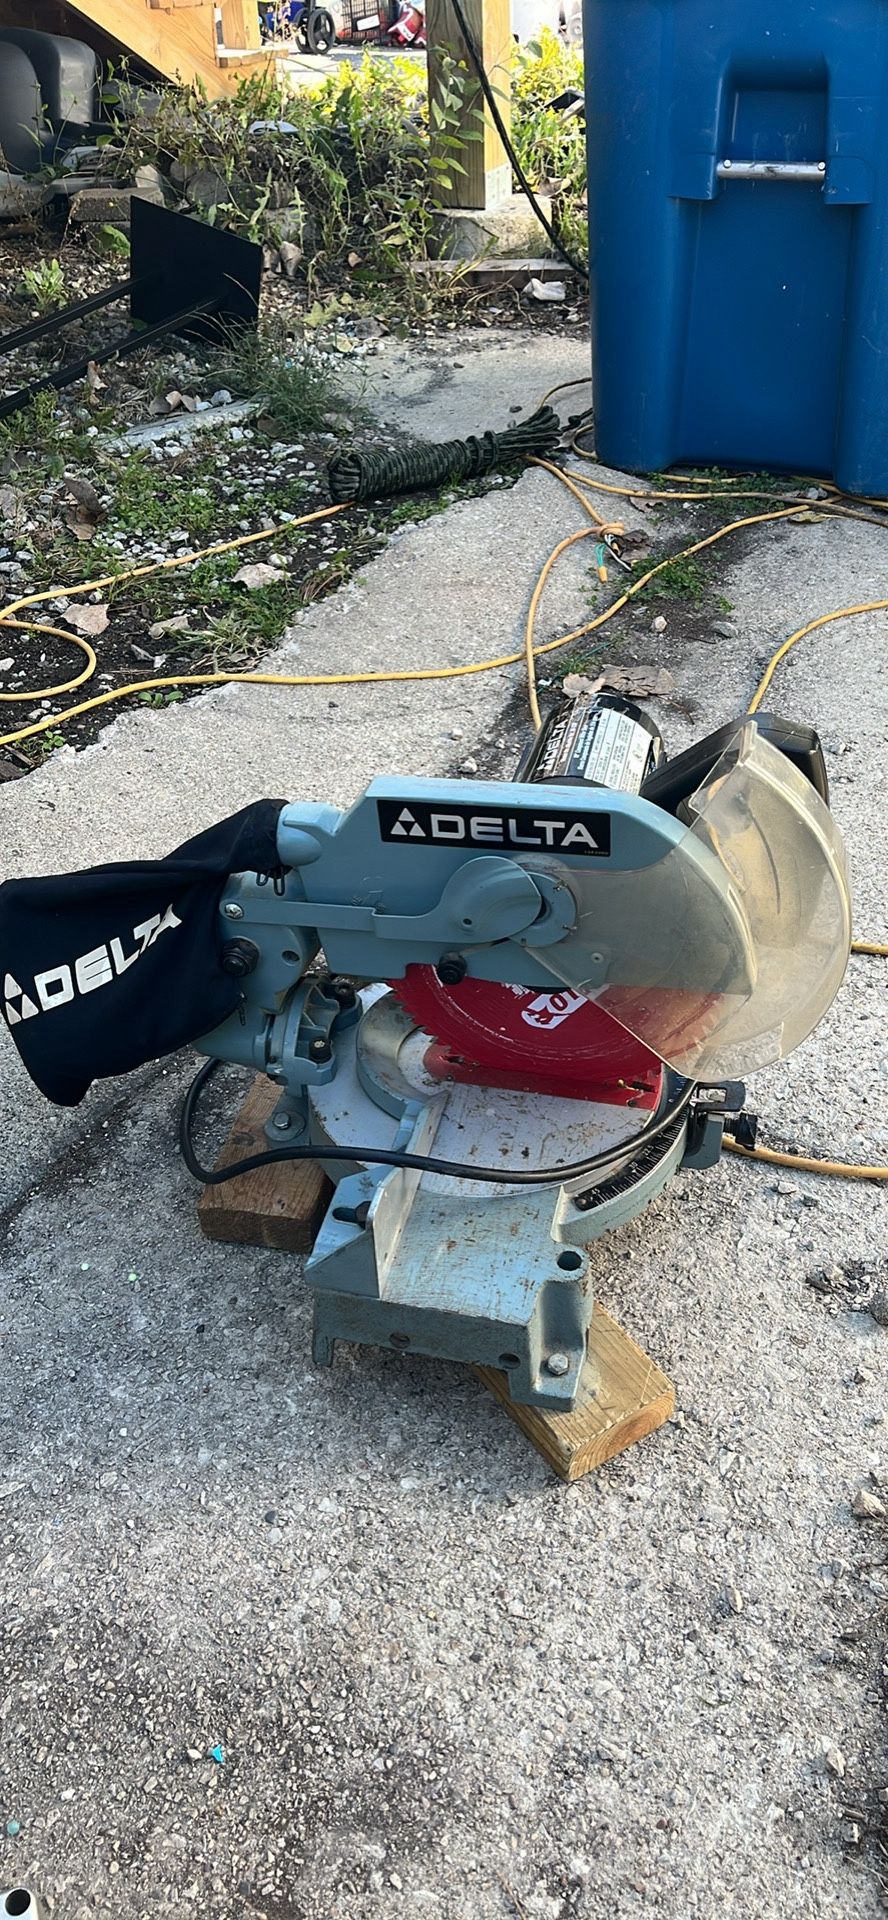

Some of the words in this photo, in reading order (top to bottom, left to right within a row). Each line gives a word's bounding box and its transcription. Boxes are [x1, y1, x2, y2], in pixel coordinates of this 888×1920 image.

[544, 719, 568, 760] DELTA
[430, 813, 599, 848] DELTA
[33, 904, 182, 1011] DELTA
